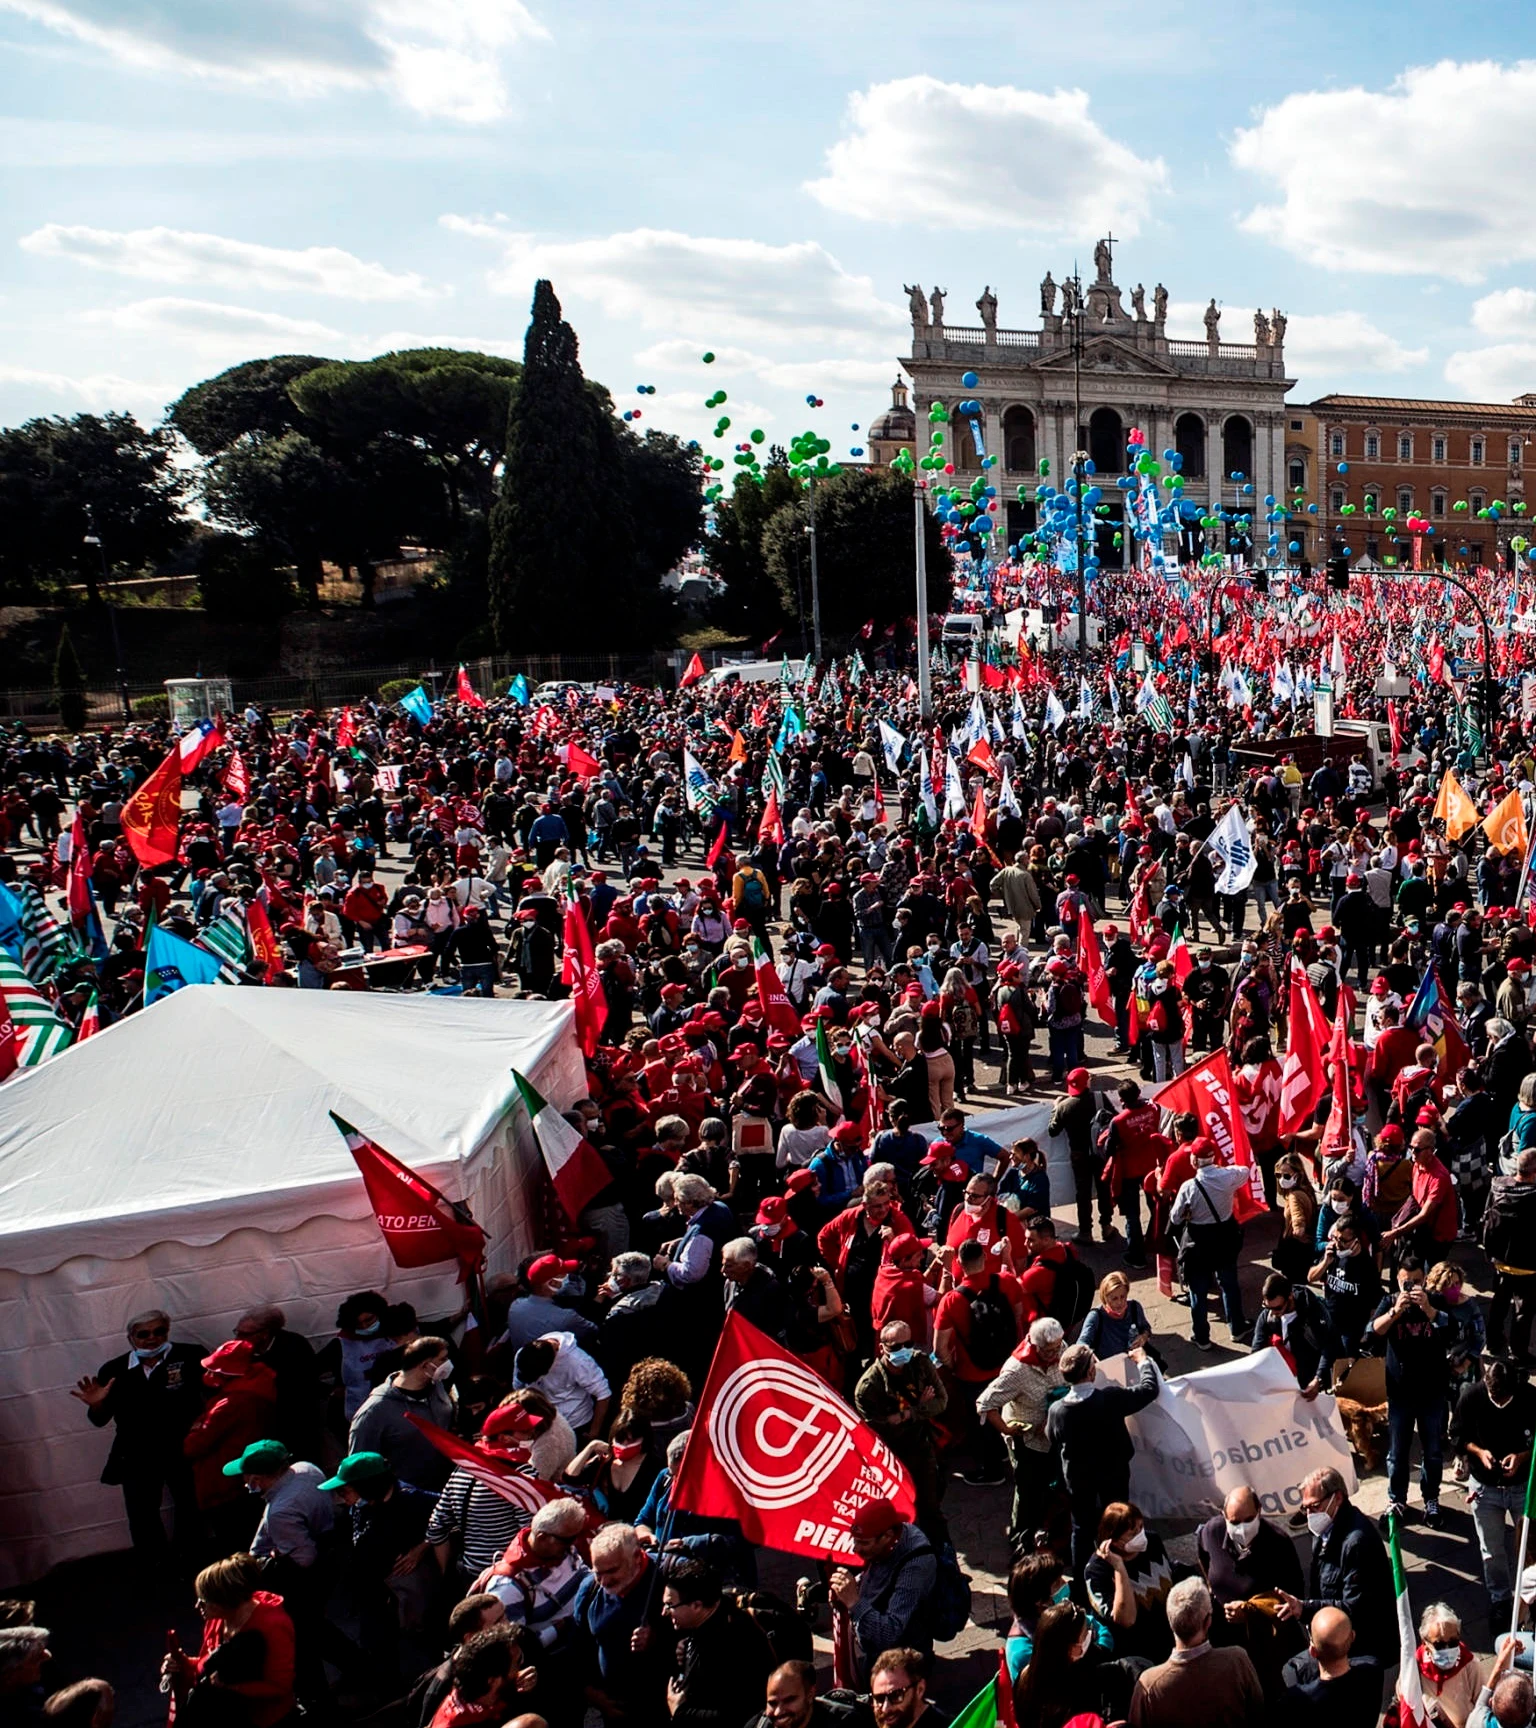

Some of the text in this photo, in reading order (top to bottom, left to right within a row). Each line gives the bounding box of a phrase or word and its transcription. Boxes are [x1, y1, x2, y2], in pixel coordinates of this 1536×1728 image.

[407, 1214, 440, 1229] PEN
[840, 1490, 869, 1509] LAV
[833, 1500, 856, 1519] TRA
